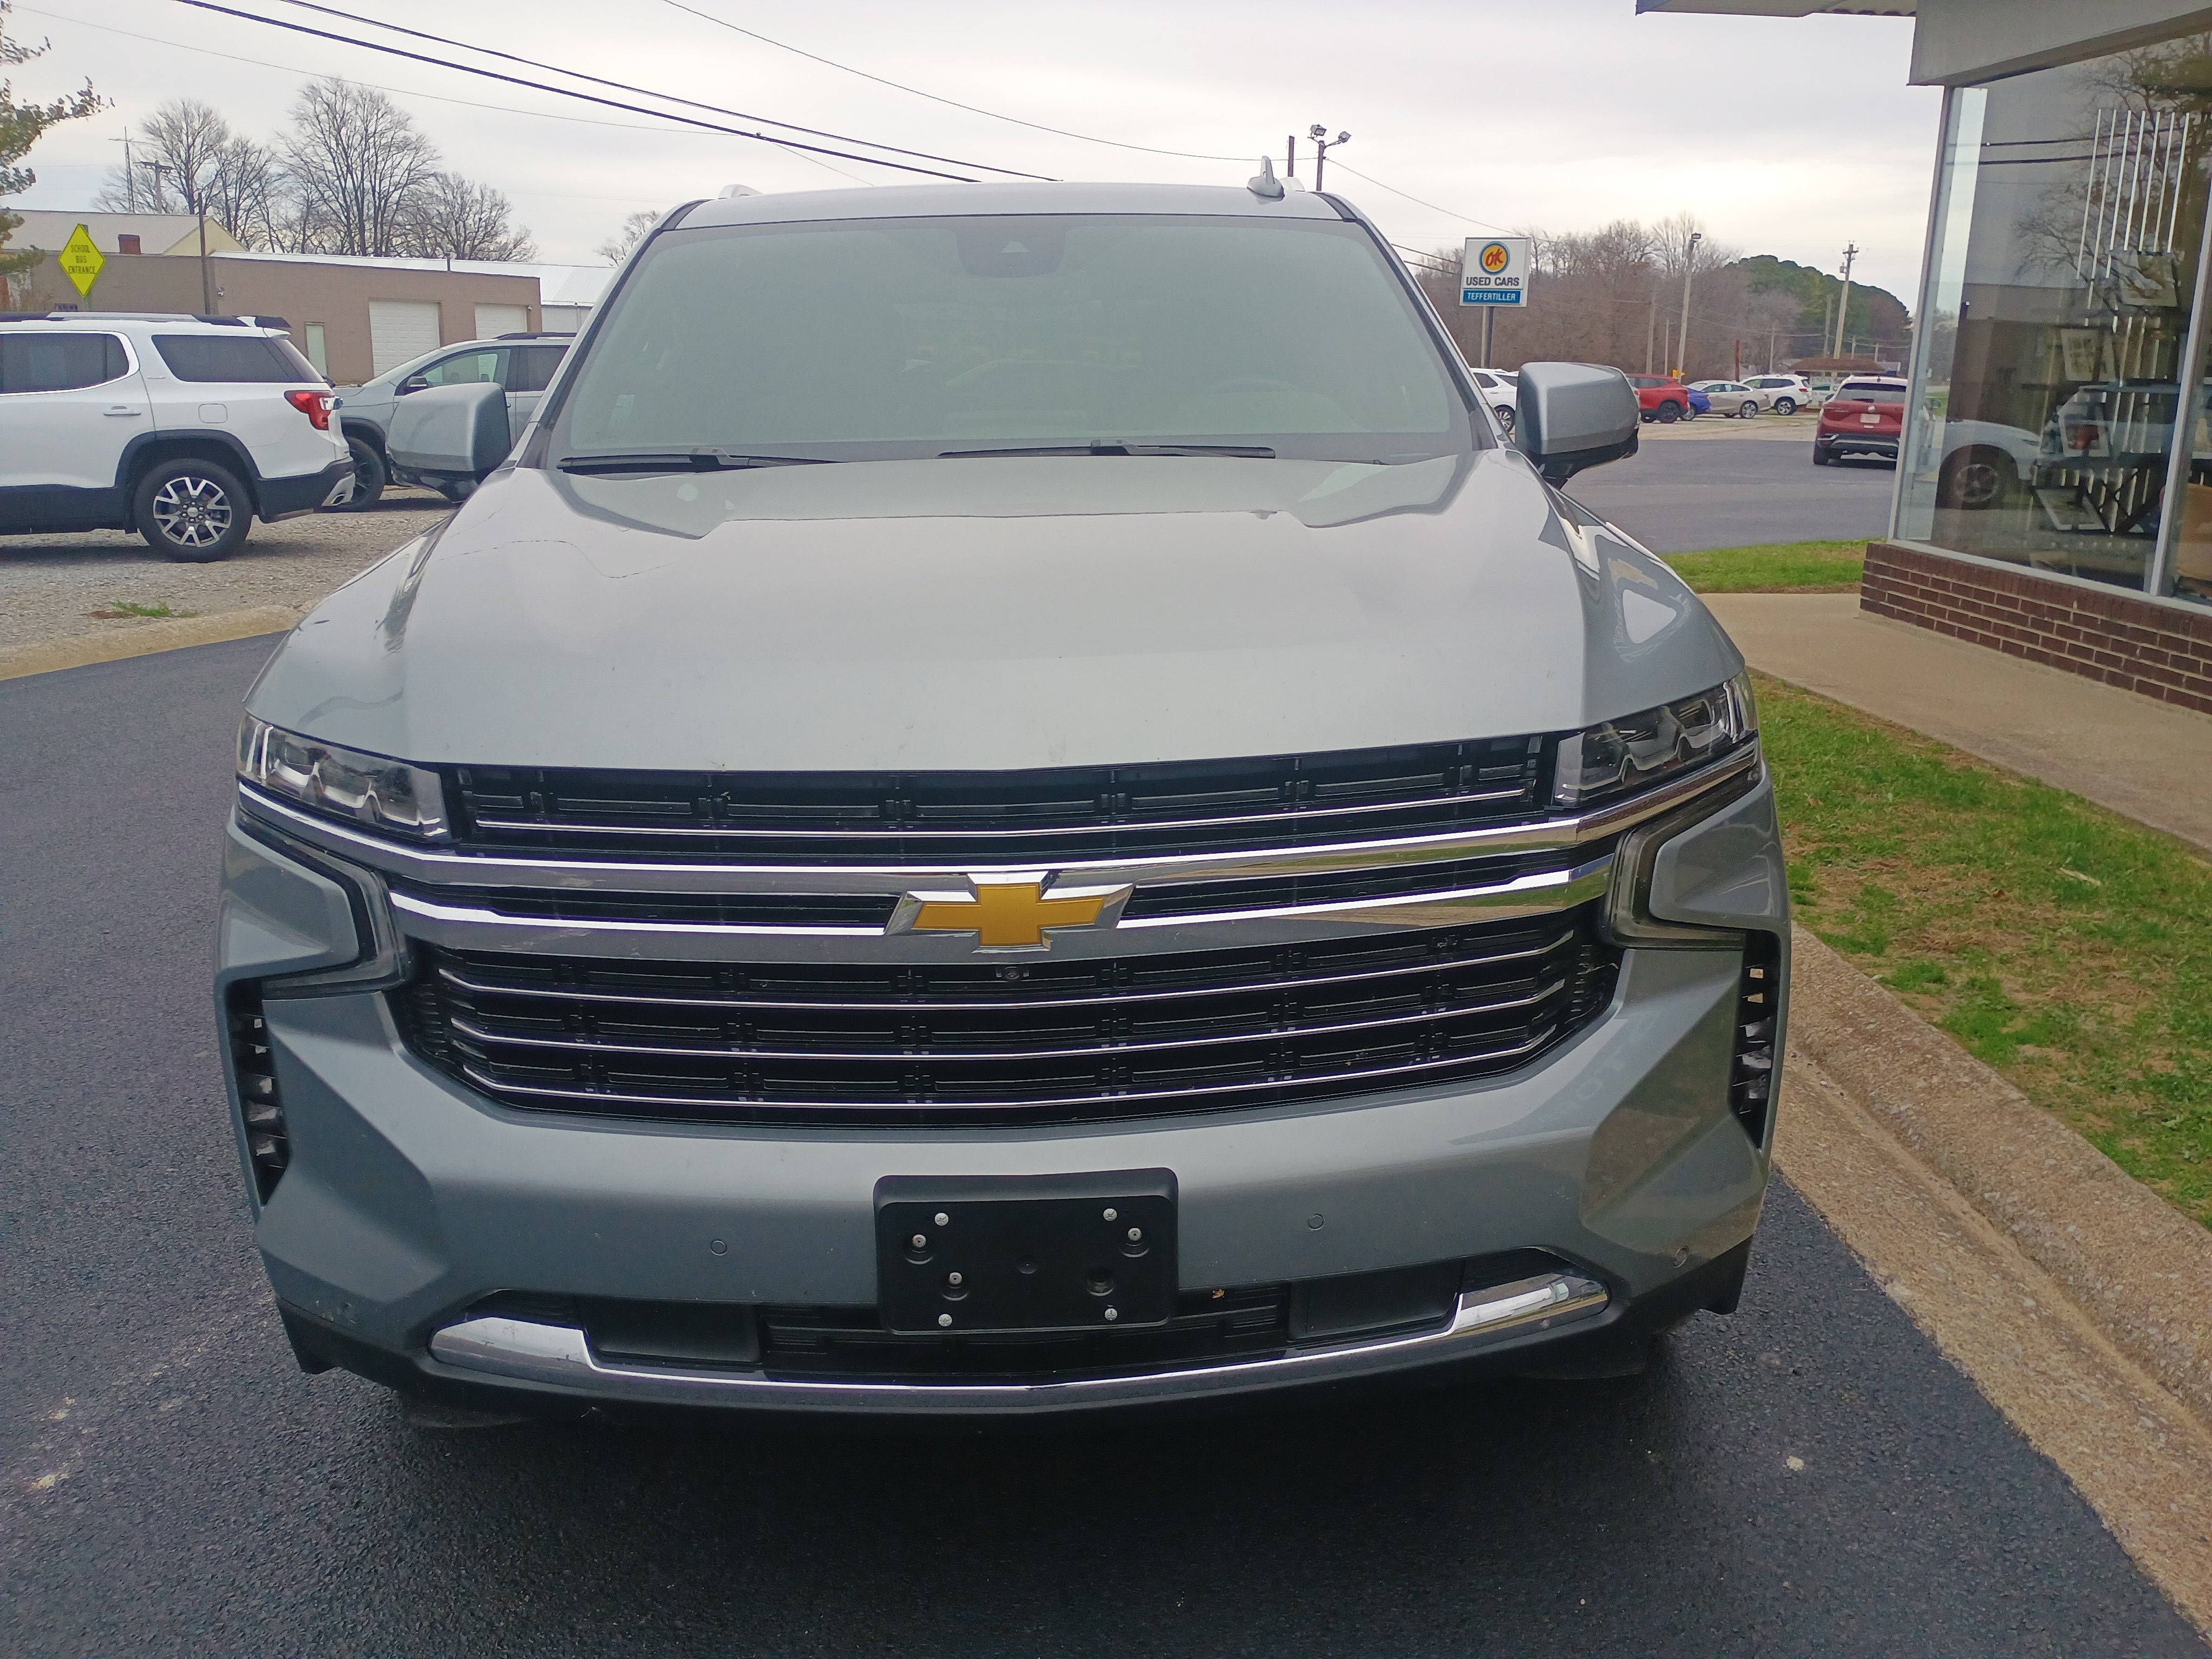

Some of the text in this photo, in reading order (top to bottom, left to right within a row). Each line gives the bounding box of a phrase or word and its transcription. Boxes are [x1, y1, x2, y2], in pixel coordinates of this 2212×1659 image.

[71, 245, 91, 253] SCHOOL
[1485, 248, 1503, 267] OK
[68, 266, 97, 274] ENTRANCE
[1466, 276, 1520, 286] USED CARS
[1467, 292, 1516, 301] TEFFERTILLER
